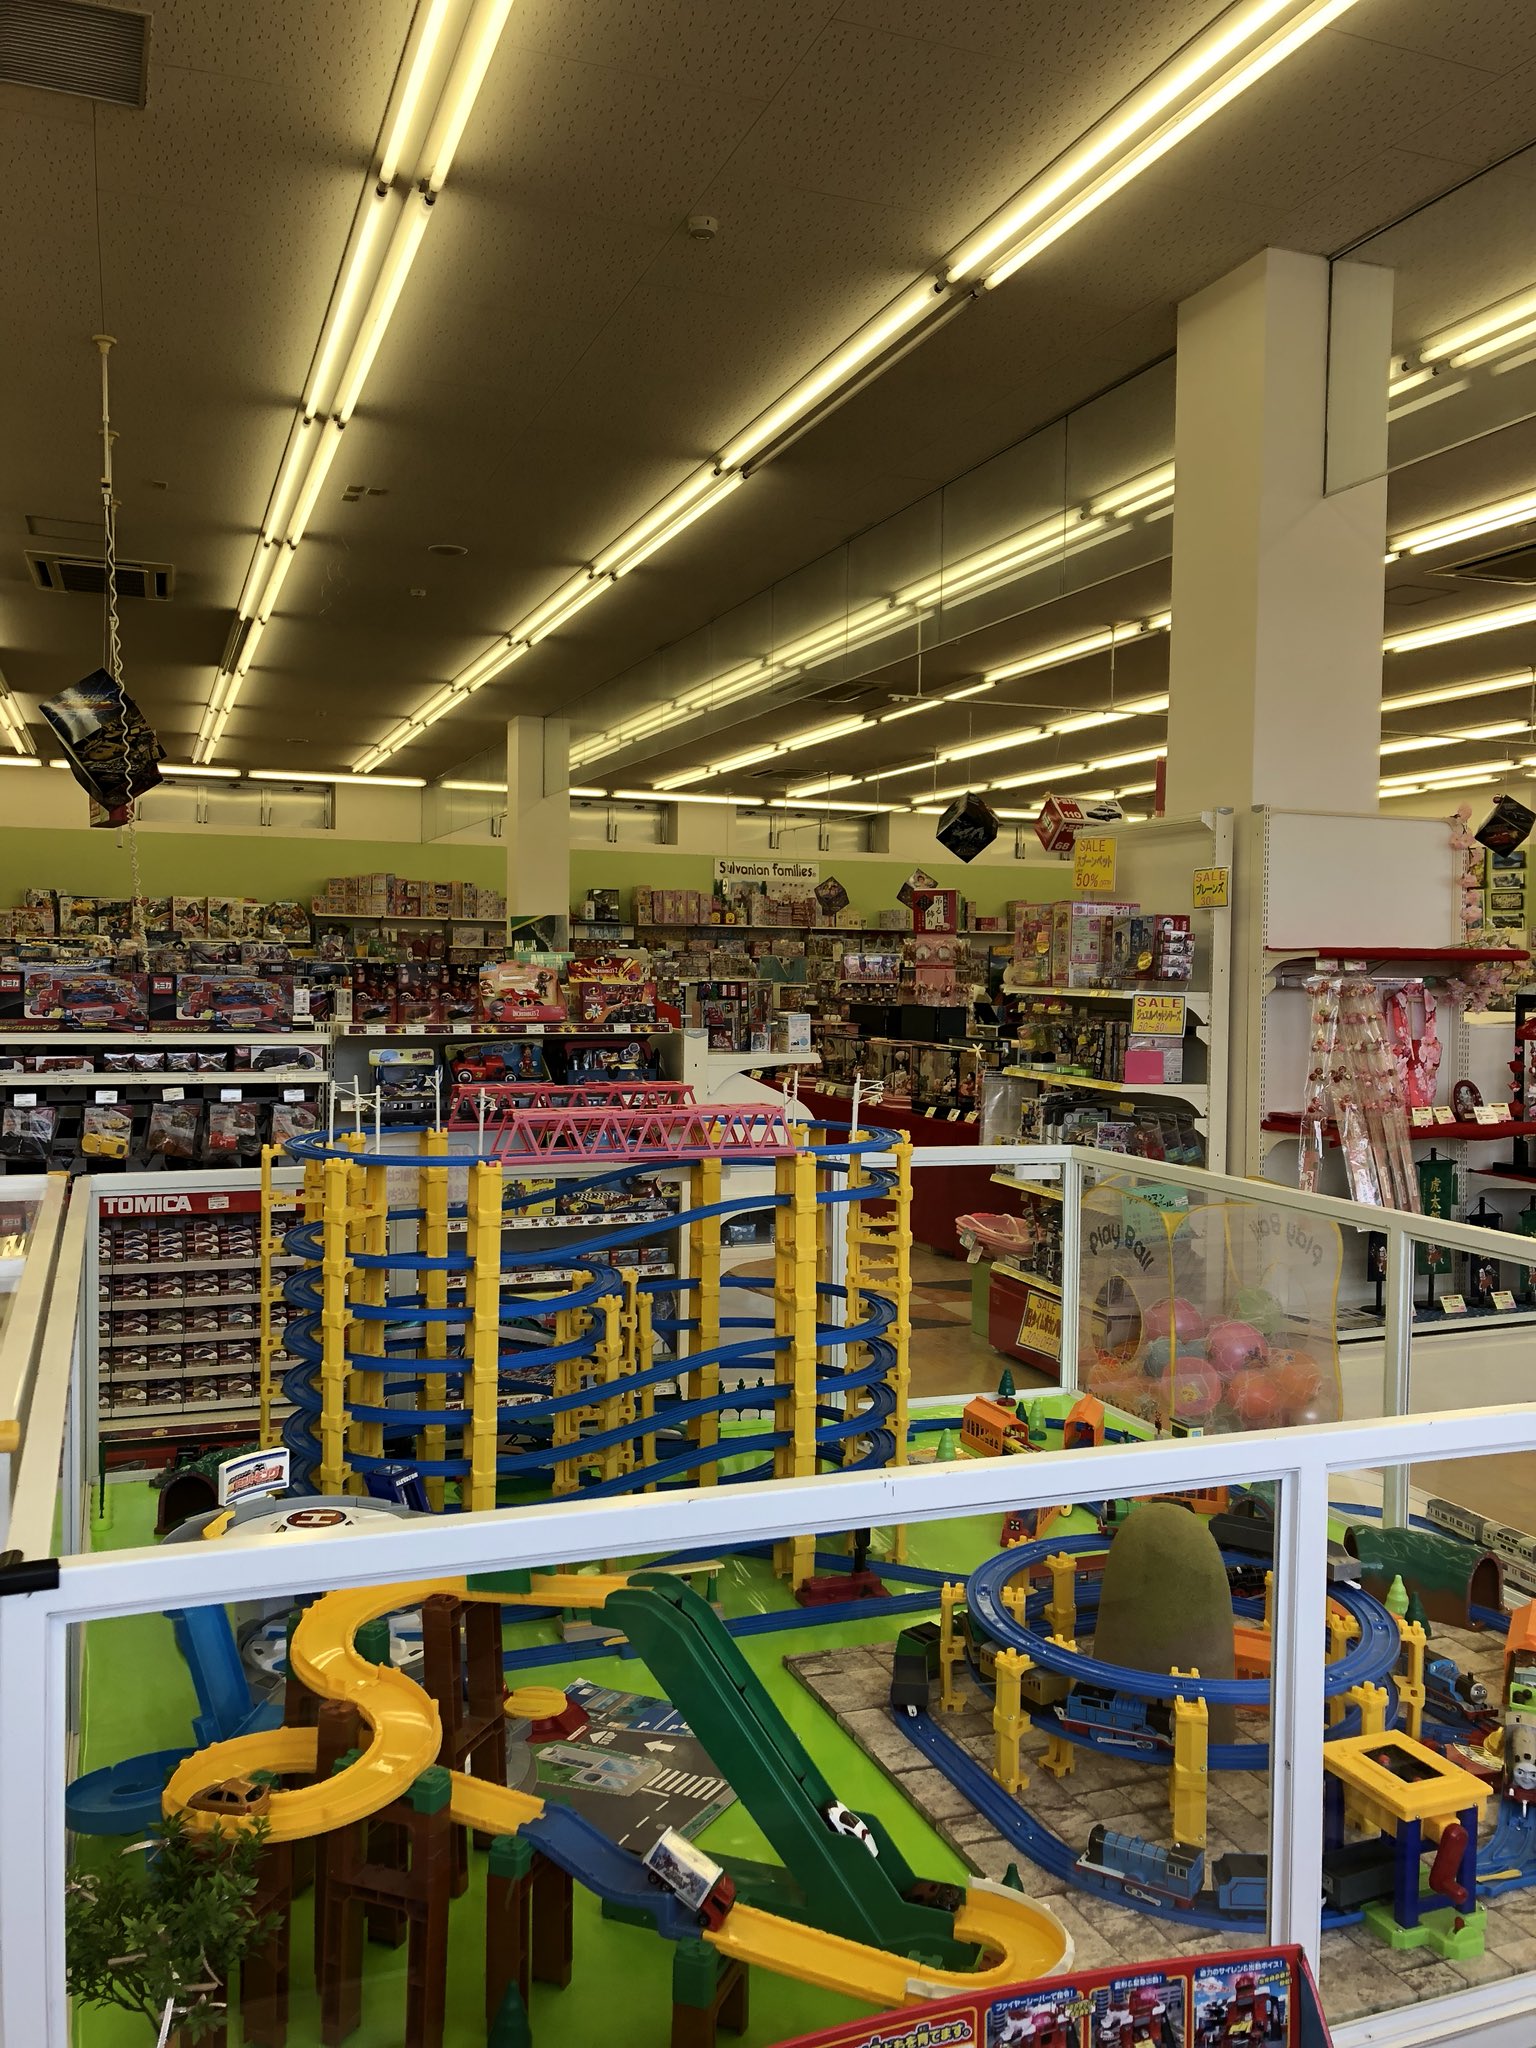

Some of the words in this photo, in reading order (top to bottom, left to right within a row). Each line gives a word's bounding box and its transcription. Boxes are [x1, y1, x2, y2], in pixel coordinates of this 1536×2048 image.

[1064, 811, 1082, 819] 110
[1055, 842, 1071, 850] 68
[1079, 839, 1106, 852] SALE
[1196, 870, 1226, 882] SALE
[1137, 997, 1182, 1009] SALE
[103, 1195, 192, 1214] TOMICA
[1036, 1299, 1057, 1315] SALE
